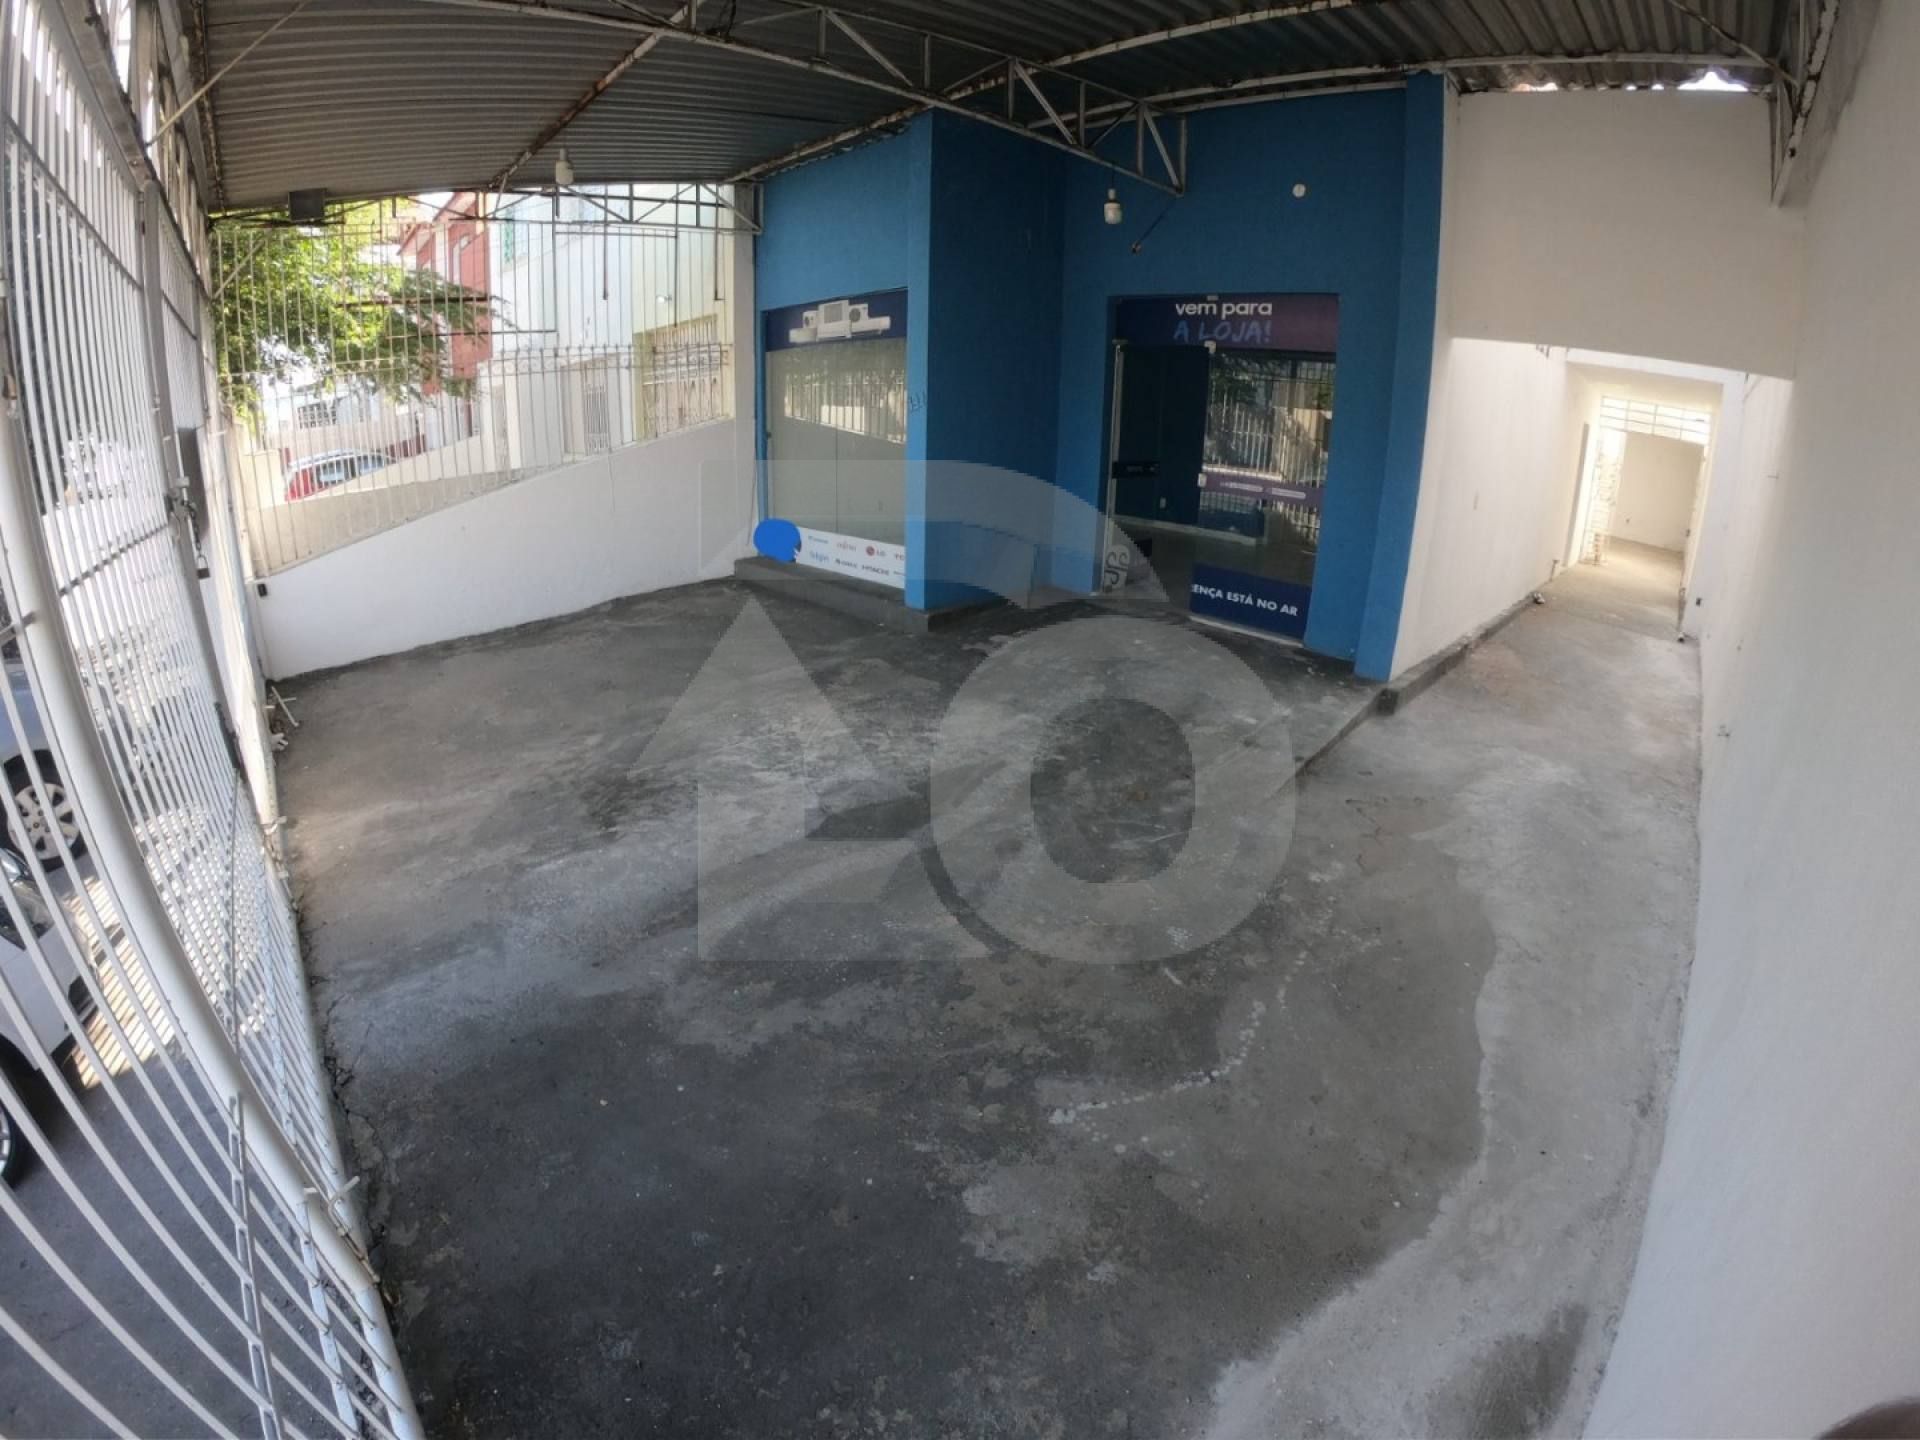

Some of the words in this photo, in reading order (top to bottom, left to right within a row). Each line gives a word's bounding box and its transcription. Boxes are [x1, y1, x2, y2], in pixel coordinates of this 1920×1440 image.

[1175, 302, 1217, 316] vem
[1222, 302, 1273, 320] para
[1173, 319, 1190, 343] A
[1198, 319, 1273, 343] LOJA!
[1191, 583, 1223, 600] ENÇA
[1227, 591, 1254, 606] ESTÁ
[1256, 598, 1278, 611] NO
[1280, 604, 1298, 617] AR
